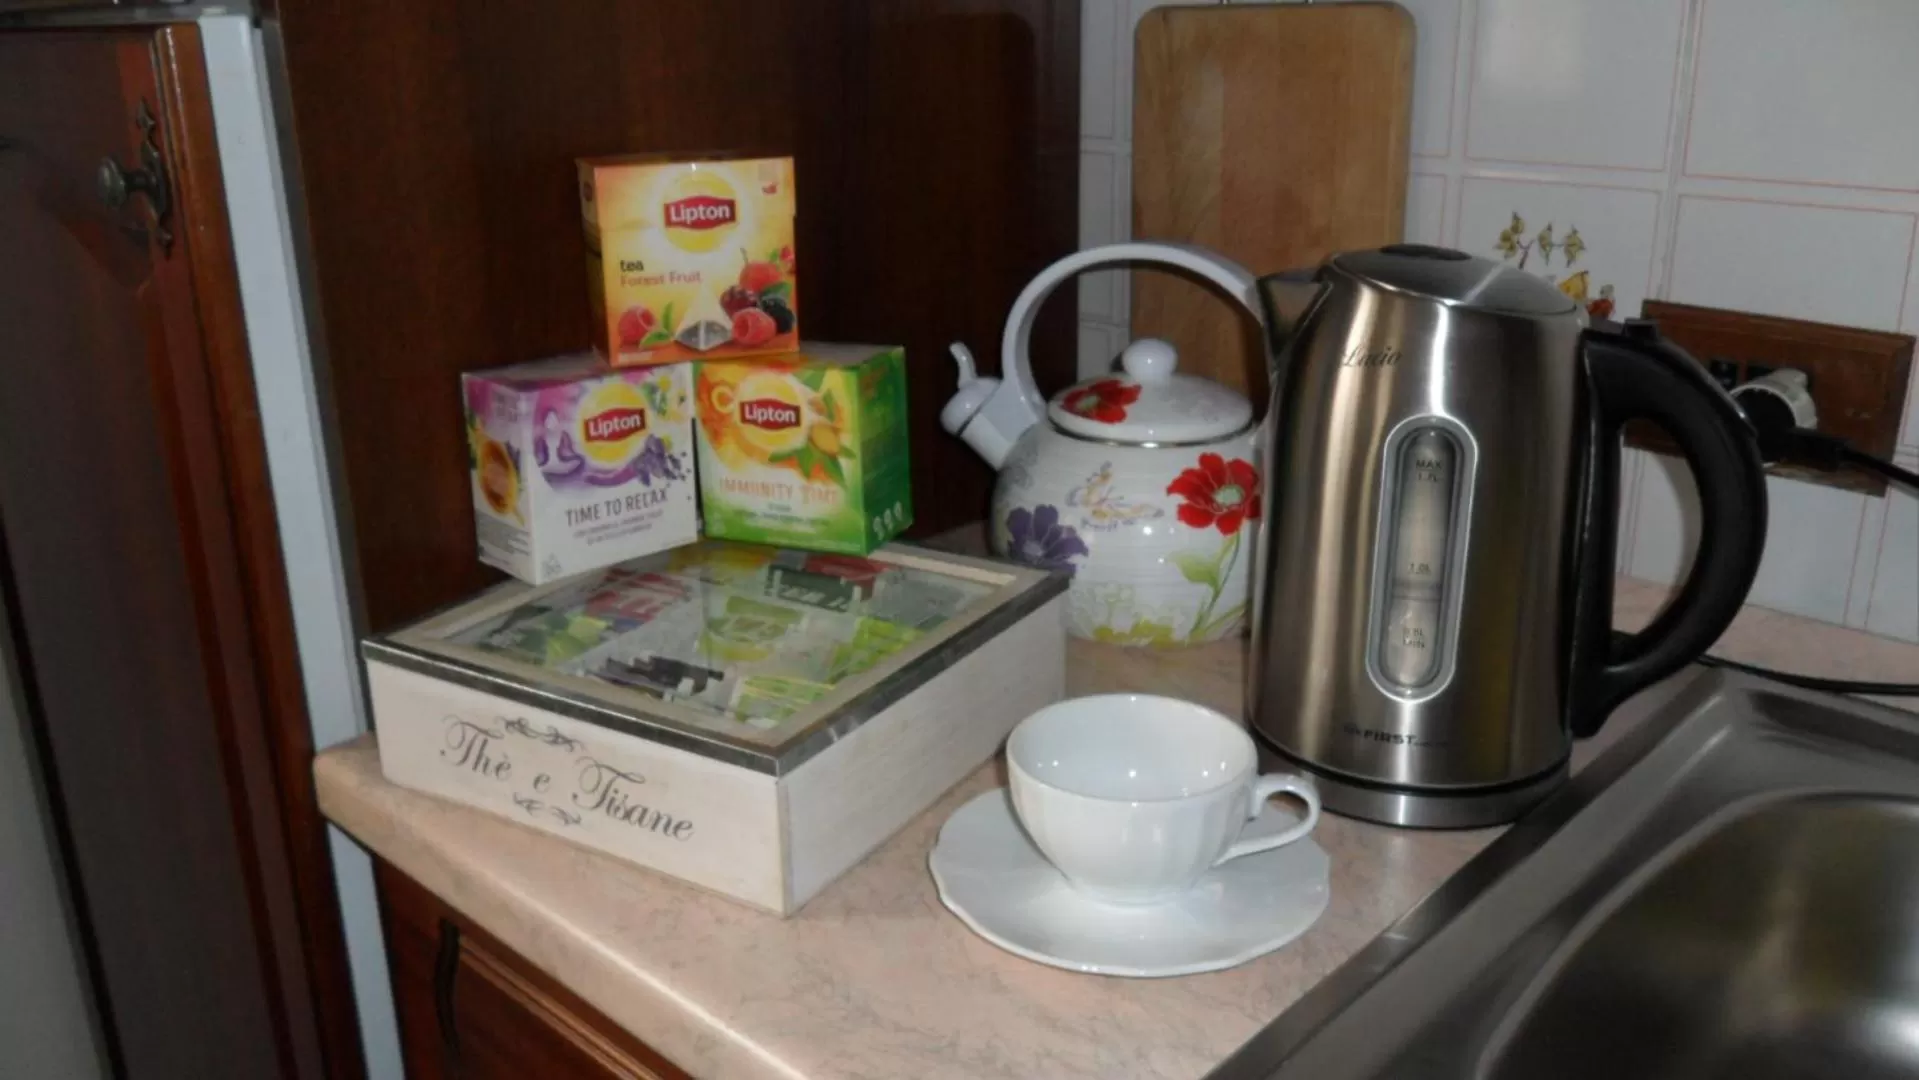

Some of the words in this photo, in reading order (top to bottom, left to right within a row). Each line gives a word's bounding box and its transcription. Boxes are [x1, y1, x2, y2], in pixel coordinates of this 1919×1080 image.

[670, 204, 730, 224] Lipton
[619, 259, 645, 272] tea
[743, 404, 796, 423] Lipton
[588, 413, 641, 437] Lipton
[1416, 459, 1442, 470] MAX
[564, 504, 600, 527] TIME
[604, 498, 622, 516] TO
[625, 488, 668, 512] RELAX
[1363, 729, 1418, 744] FIRST
[532, 773, 551, 793] e
[571, 755, 695, 842] Tisane
